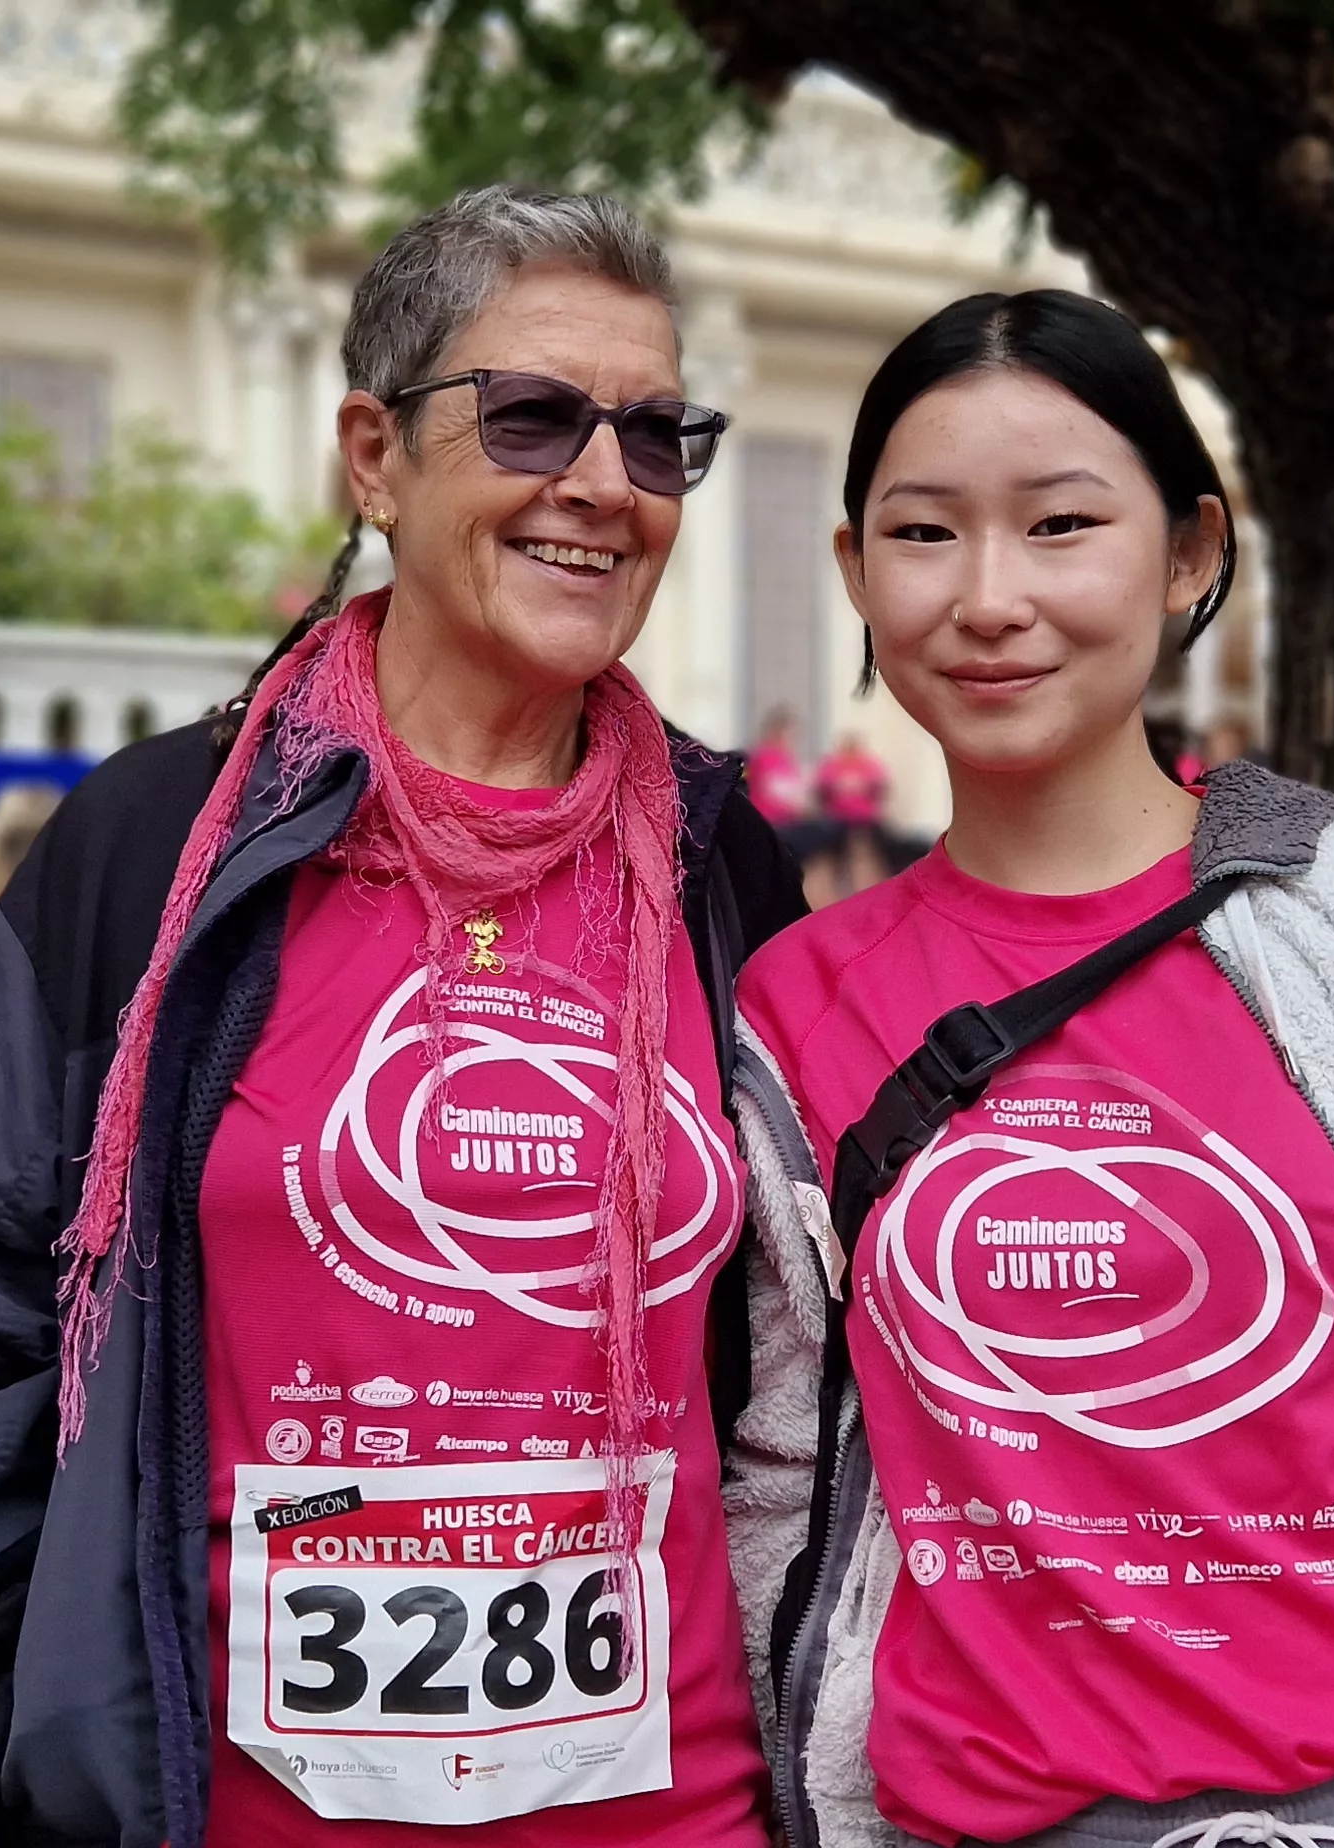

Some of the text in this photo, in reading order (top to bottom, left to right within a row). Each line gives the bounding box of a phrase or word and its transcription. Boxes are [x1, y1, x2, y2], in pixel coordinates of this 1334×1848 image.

[454, 983, 531, 1004] CARRERA
[542, 996, 605, 1026] HUESCA
[449, 999, 605, 1040] CONTRA EL CÁNCER
[441, 1104, 584, 1139] Caminemos
[983, 1098, 1151, 1119] X CARRERA HUESCA
[992, 1111, 1152, 1135] CONTRA EL CÁNCER
[450, 1138, 578, 1176] JUNTOS
[282, 1143, 302, 1163] Te
[319, 1243, 340, 1268] Te
[334, 1262, 401, 1314] escucho,
[404, 1295, 424, 1318] Te
[425, 1303, 475, 1328] apoyo
[976, 1216, 1126, 1245] Caminemos
[987, 1251, 1117, 1290] JUNTOS
[271, 1382, 341, 1402] podoactiva
[360, 1387, 410, 1401] Ferrer
[453, 1387, 483, 1401] hoya
[500, 1389, 544, 1402] huesca
[435, 1434, 508, 1452] Alcampo
[968, 1417, 987, 1438] Te
[990, 1424, 1039, 1452] apoyo
[267, 1494, 349, 1528] X EDICIÓN
[423, 1502, 533, 1530] HUESCA
[1081, 1514, 1128, 1527] huesca
[1135, 1508, 1204, 1538] vive
[1228, 1513, 1305, 1528] URBAN
[292, 1535, 452, 1563] CONTRA
[463, 1534, 503, 1563] EL
[1036, 1554, 1104, 1575] Alcampo
[1114, 1560, 1170, 1581] eboca
[1207, 1560, 1282, 1576] Humeco
[282, 1569, 634, 1715] 3286
[311, 1761, 397, 1774] hoya de huesca
